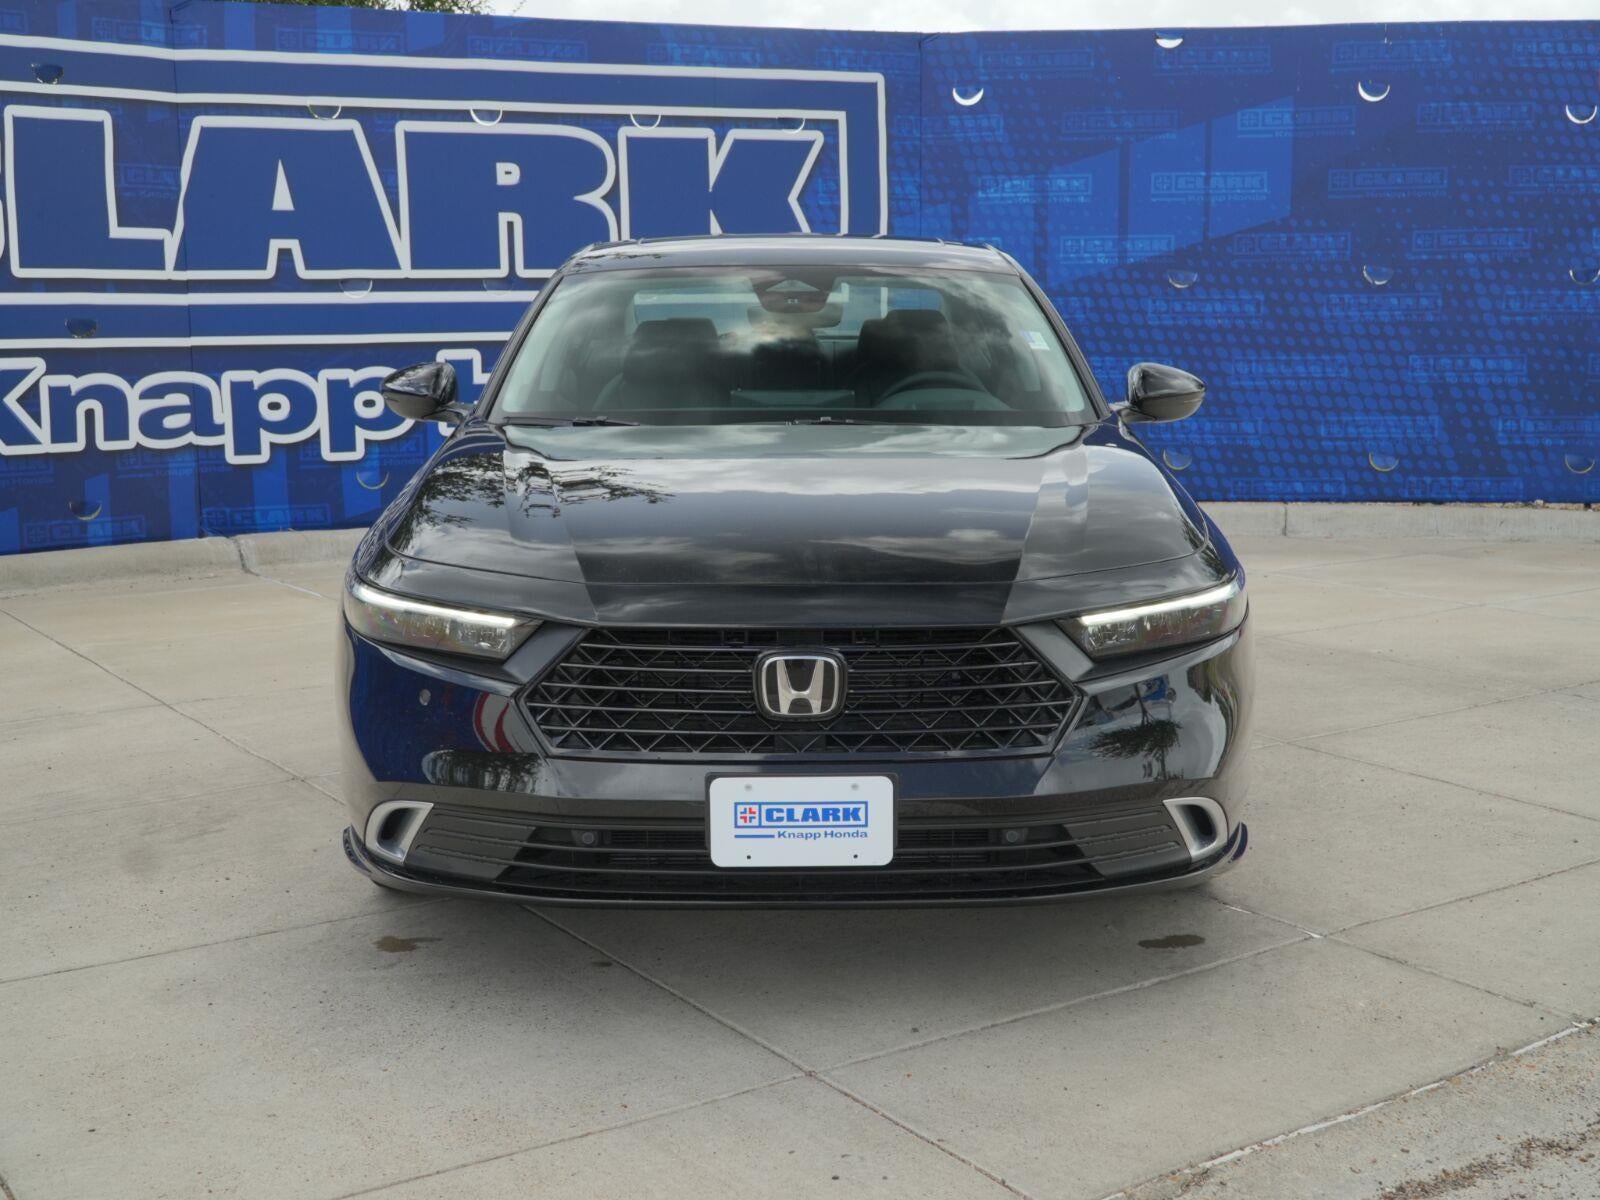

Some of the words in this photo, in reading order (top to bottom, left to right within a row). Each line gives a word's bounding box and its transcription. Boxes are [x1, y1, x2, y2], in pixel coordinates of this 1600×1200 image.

[1004, 178, 1087, 192] CLRK
[1177, 176, 1262, 189] CLARK
[0, 104, 825, 280] LARK
[765, 807, 862, 822] CLARK
[777, 831, 821, 840] Knapp
[824, 829, 868, 839] Honda
